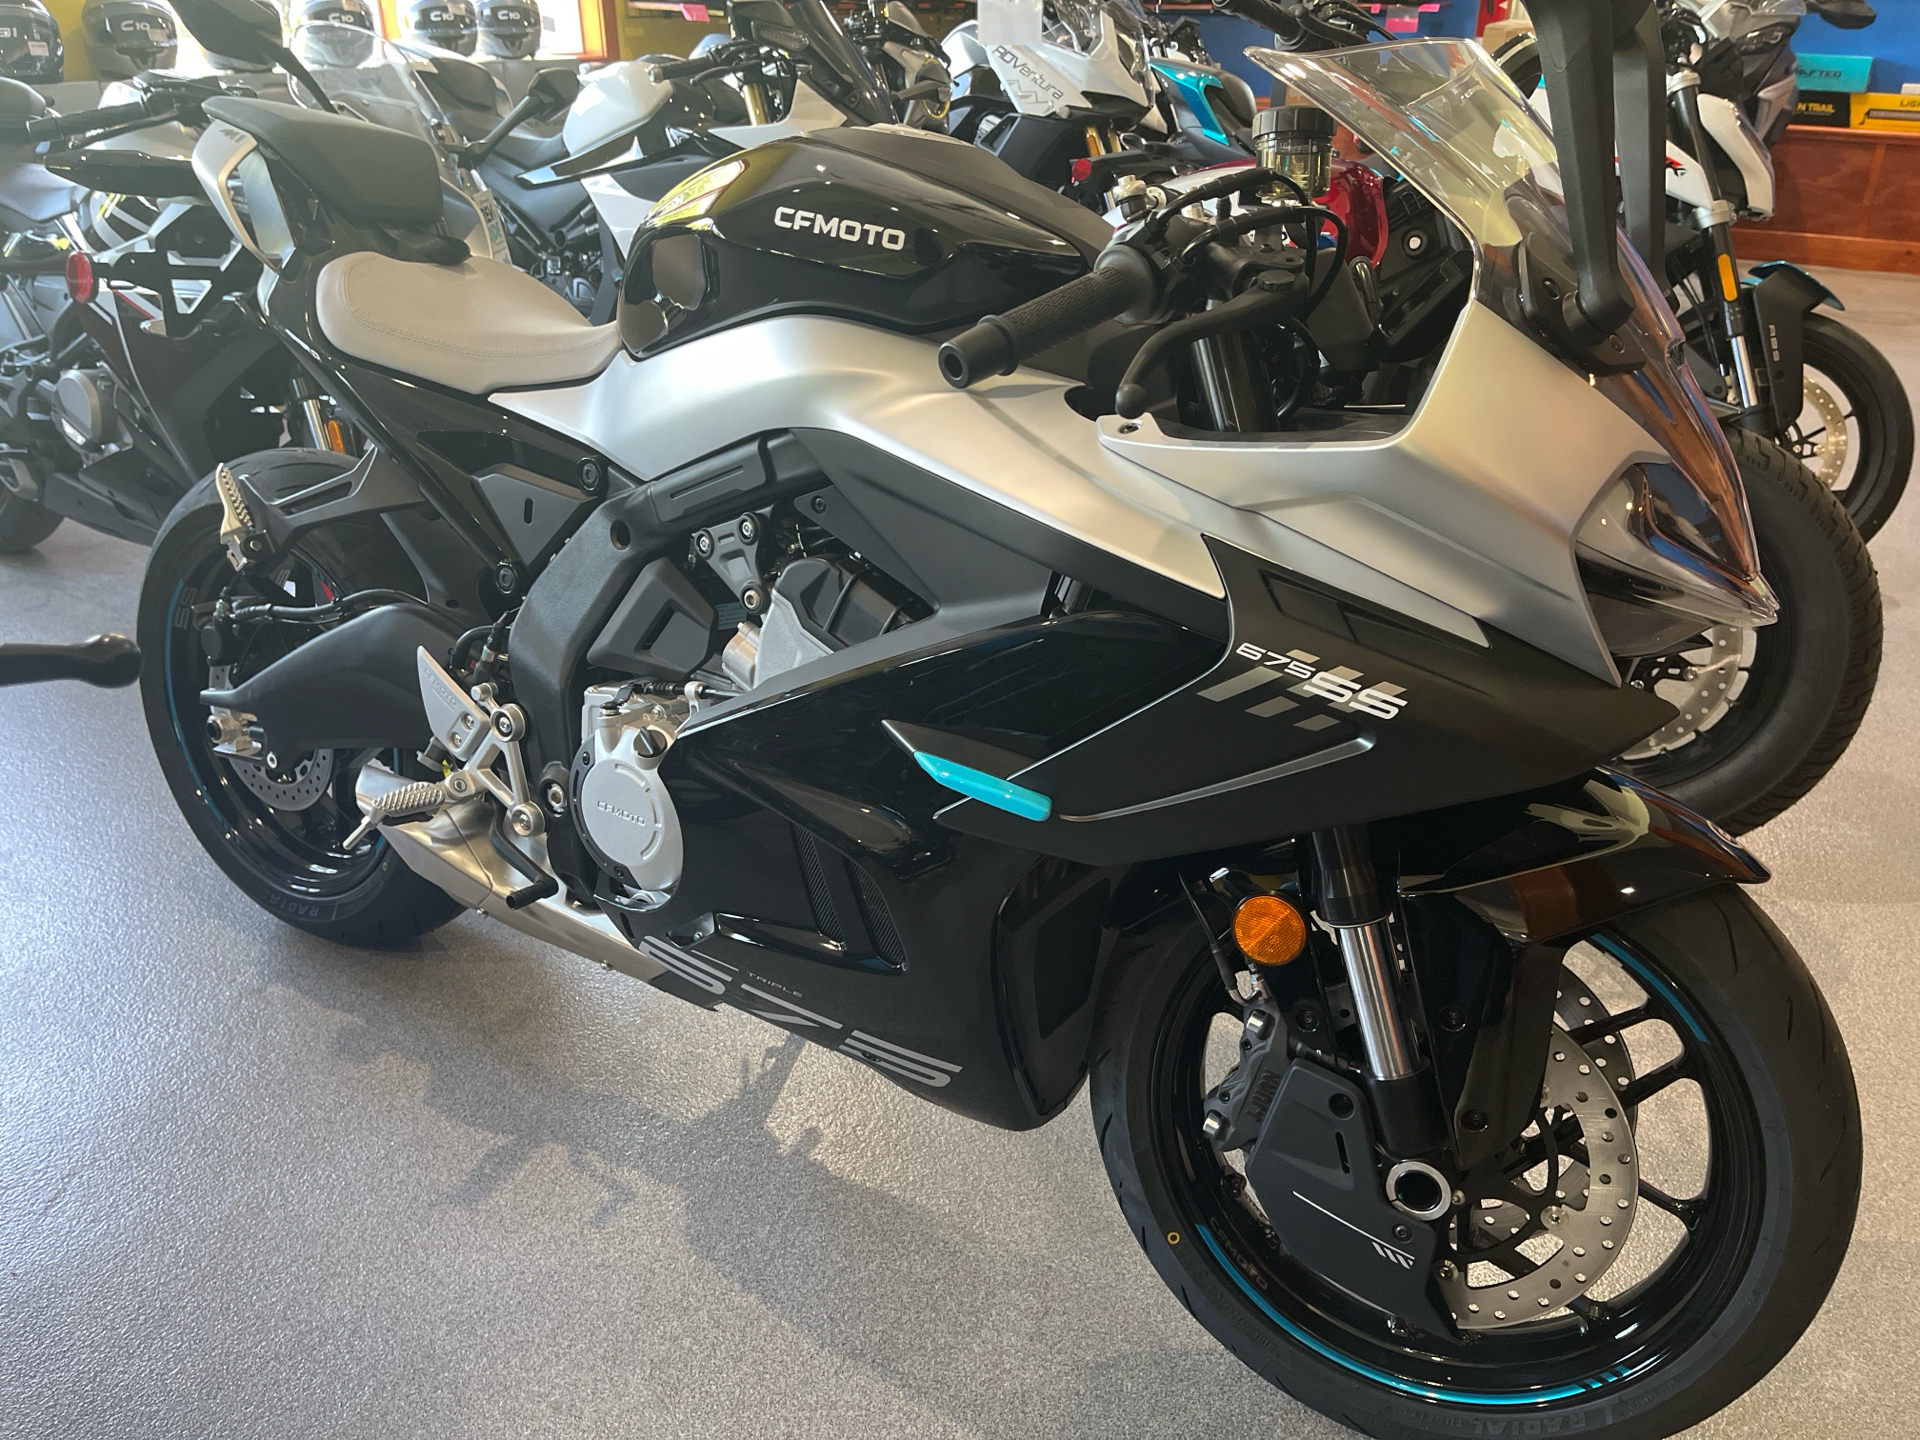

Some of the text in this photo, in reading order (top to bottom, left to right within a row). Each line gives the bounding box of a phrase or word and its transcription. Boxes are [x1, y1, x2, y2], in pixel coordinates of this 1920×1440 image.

[774, 206, 906, 251] CFMOTO
[597, 800, 646, 827] CFMOTO
[263, 889, 320, 917] RADIAL
[747, 971, 804, 998] TRIPLE
[1210, 1217, 1269, 1290] CFMOTO
[1472, 1410, 1588, 1436] RADIAL
